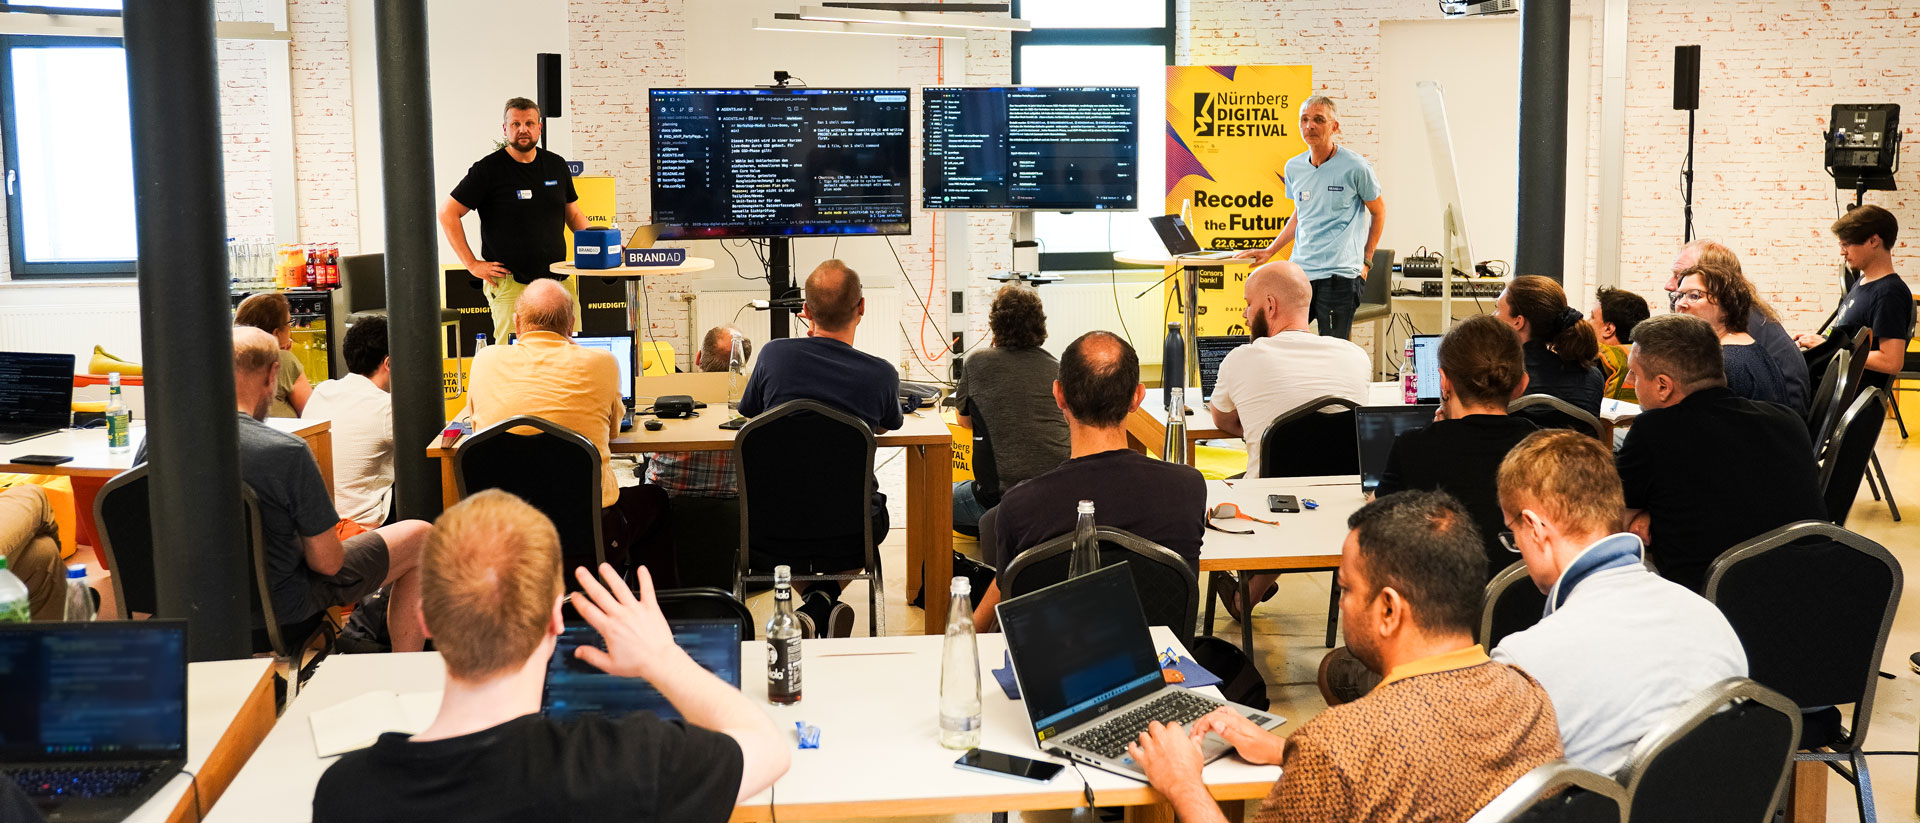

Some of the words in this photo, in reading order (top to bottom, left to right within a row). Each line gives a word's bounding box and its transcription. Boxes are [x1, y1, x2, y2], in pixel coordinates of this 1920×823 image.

[1218, 92, 1288, 108] Nürnberg
[1218, 108, 1278, 120] DIGITAL
[1218, 124, 1287, 136] FESTIVAL
[1194, 190, 1273, 208] Recode
[1204, 220, 1226, 230] the
[1230, 214, 1291, 230] Futur
[630, 253, 680, 262] BRANDAD
[953, 441, 970, 454] berg
[952, 451, 965, 460] TAL
[953, 461, 970, 471] IVAL
